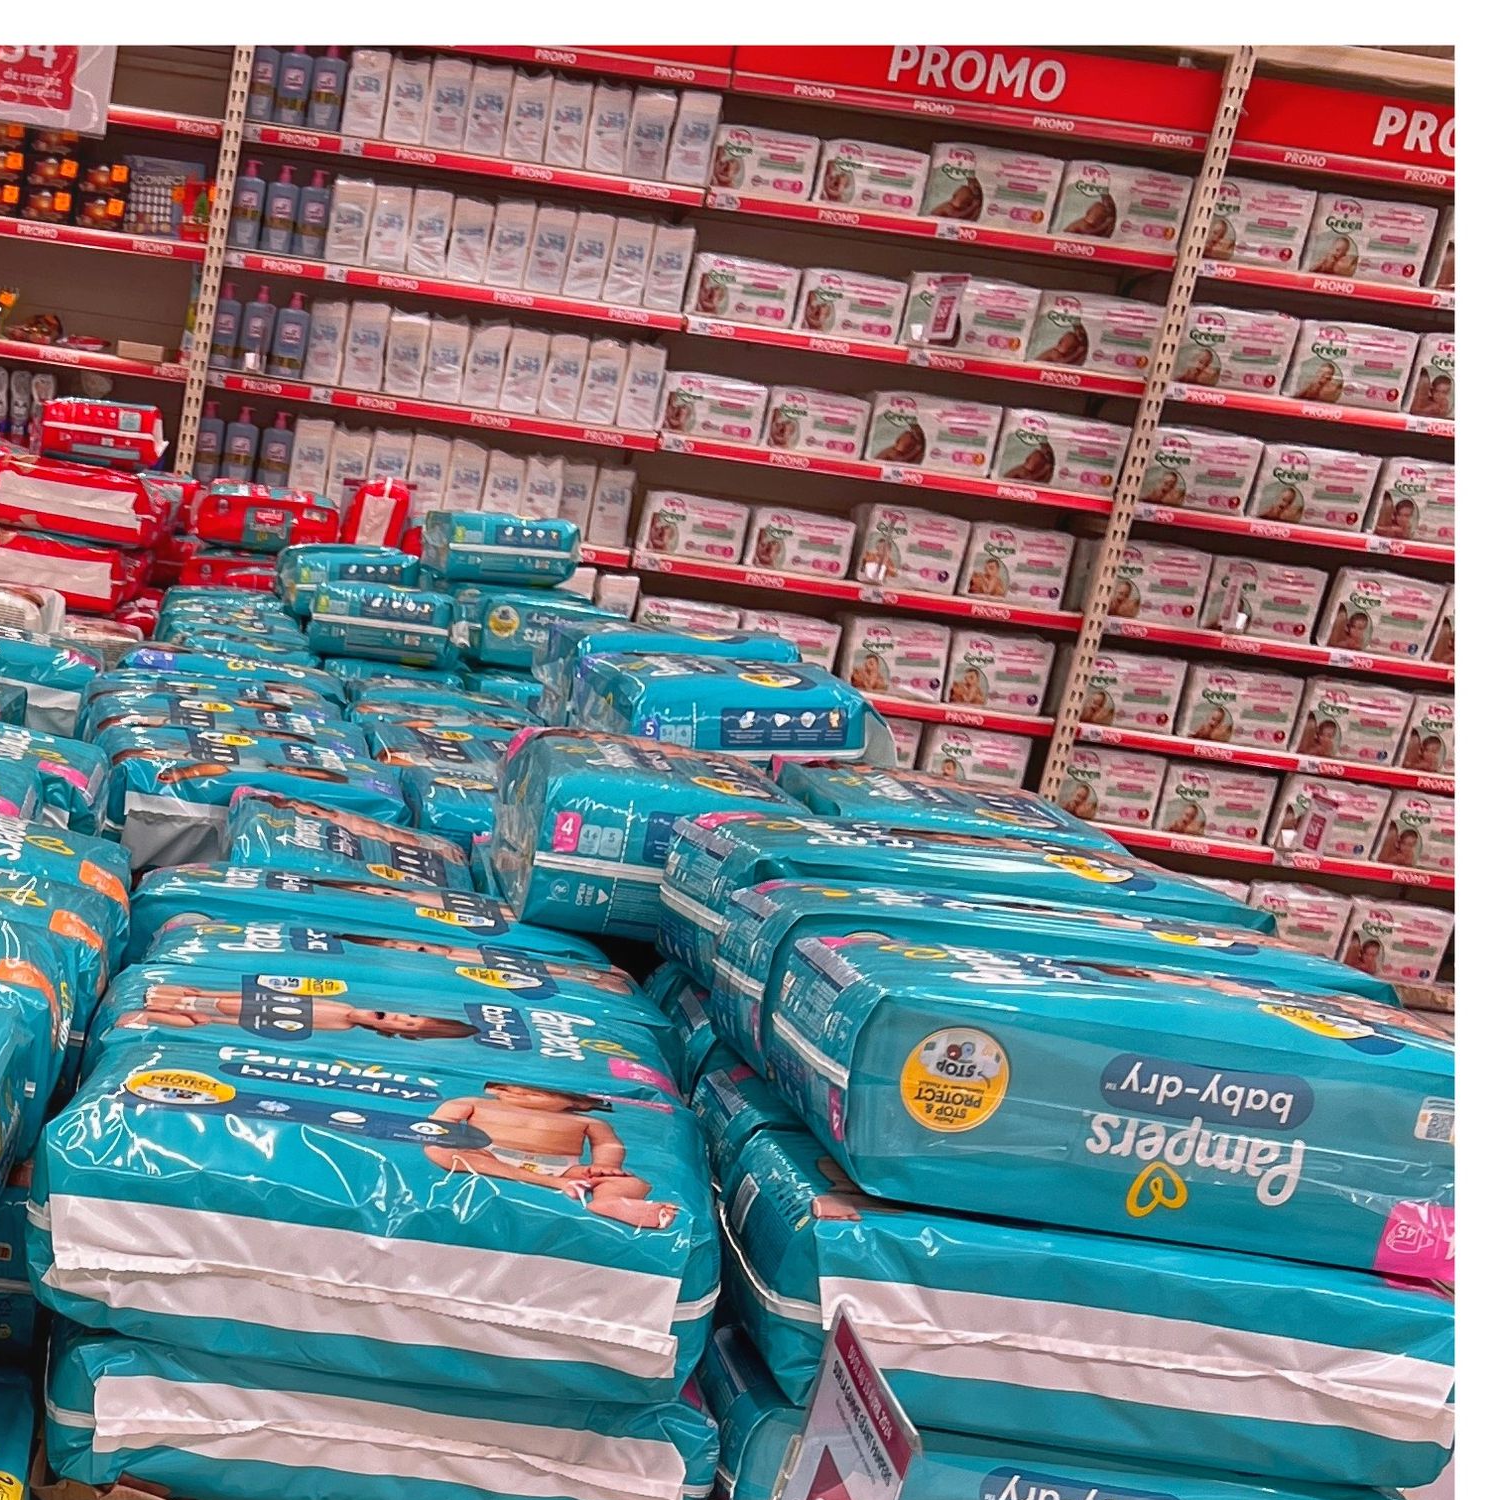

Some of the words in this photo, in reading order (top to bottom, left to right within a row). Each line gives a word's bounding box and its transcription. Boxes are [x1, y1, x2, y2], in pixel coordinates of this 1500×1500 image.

[535, 49, 577, 64] PROMO
[887, 45, 1067, 102] PROMO
[794, 84, 836, 99] PROMO
[1152, 133, 1194, 146] PROMO
[395, 149, 437, 164] PROMO
[1284, 152, 1327, 167] PROMO
[818, 208, 860, 224] PROMO
[1326, 216, 1363, 232] Green
[377, 276, 419, 291] PROMO
[1313, 279, 1355, 294] PROMO
[1190, 331, 1225, 343] Green
[1300, 405, 1342, 420] PROMO
[560, 818, 574, 836] 4
[936, 1060, 976, 1077] STOP
[914, 1087, 983, 1108] PROTECT
[1120, 1059, 1294, 1124] baby-dry
[935, 1106, 967, 1119] STOP
[1086, 1113, 1306, 1206] Pampers
